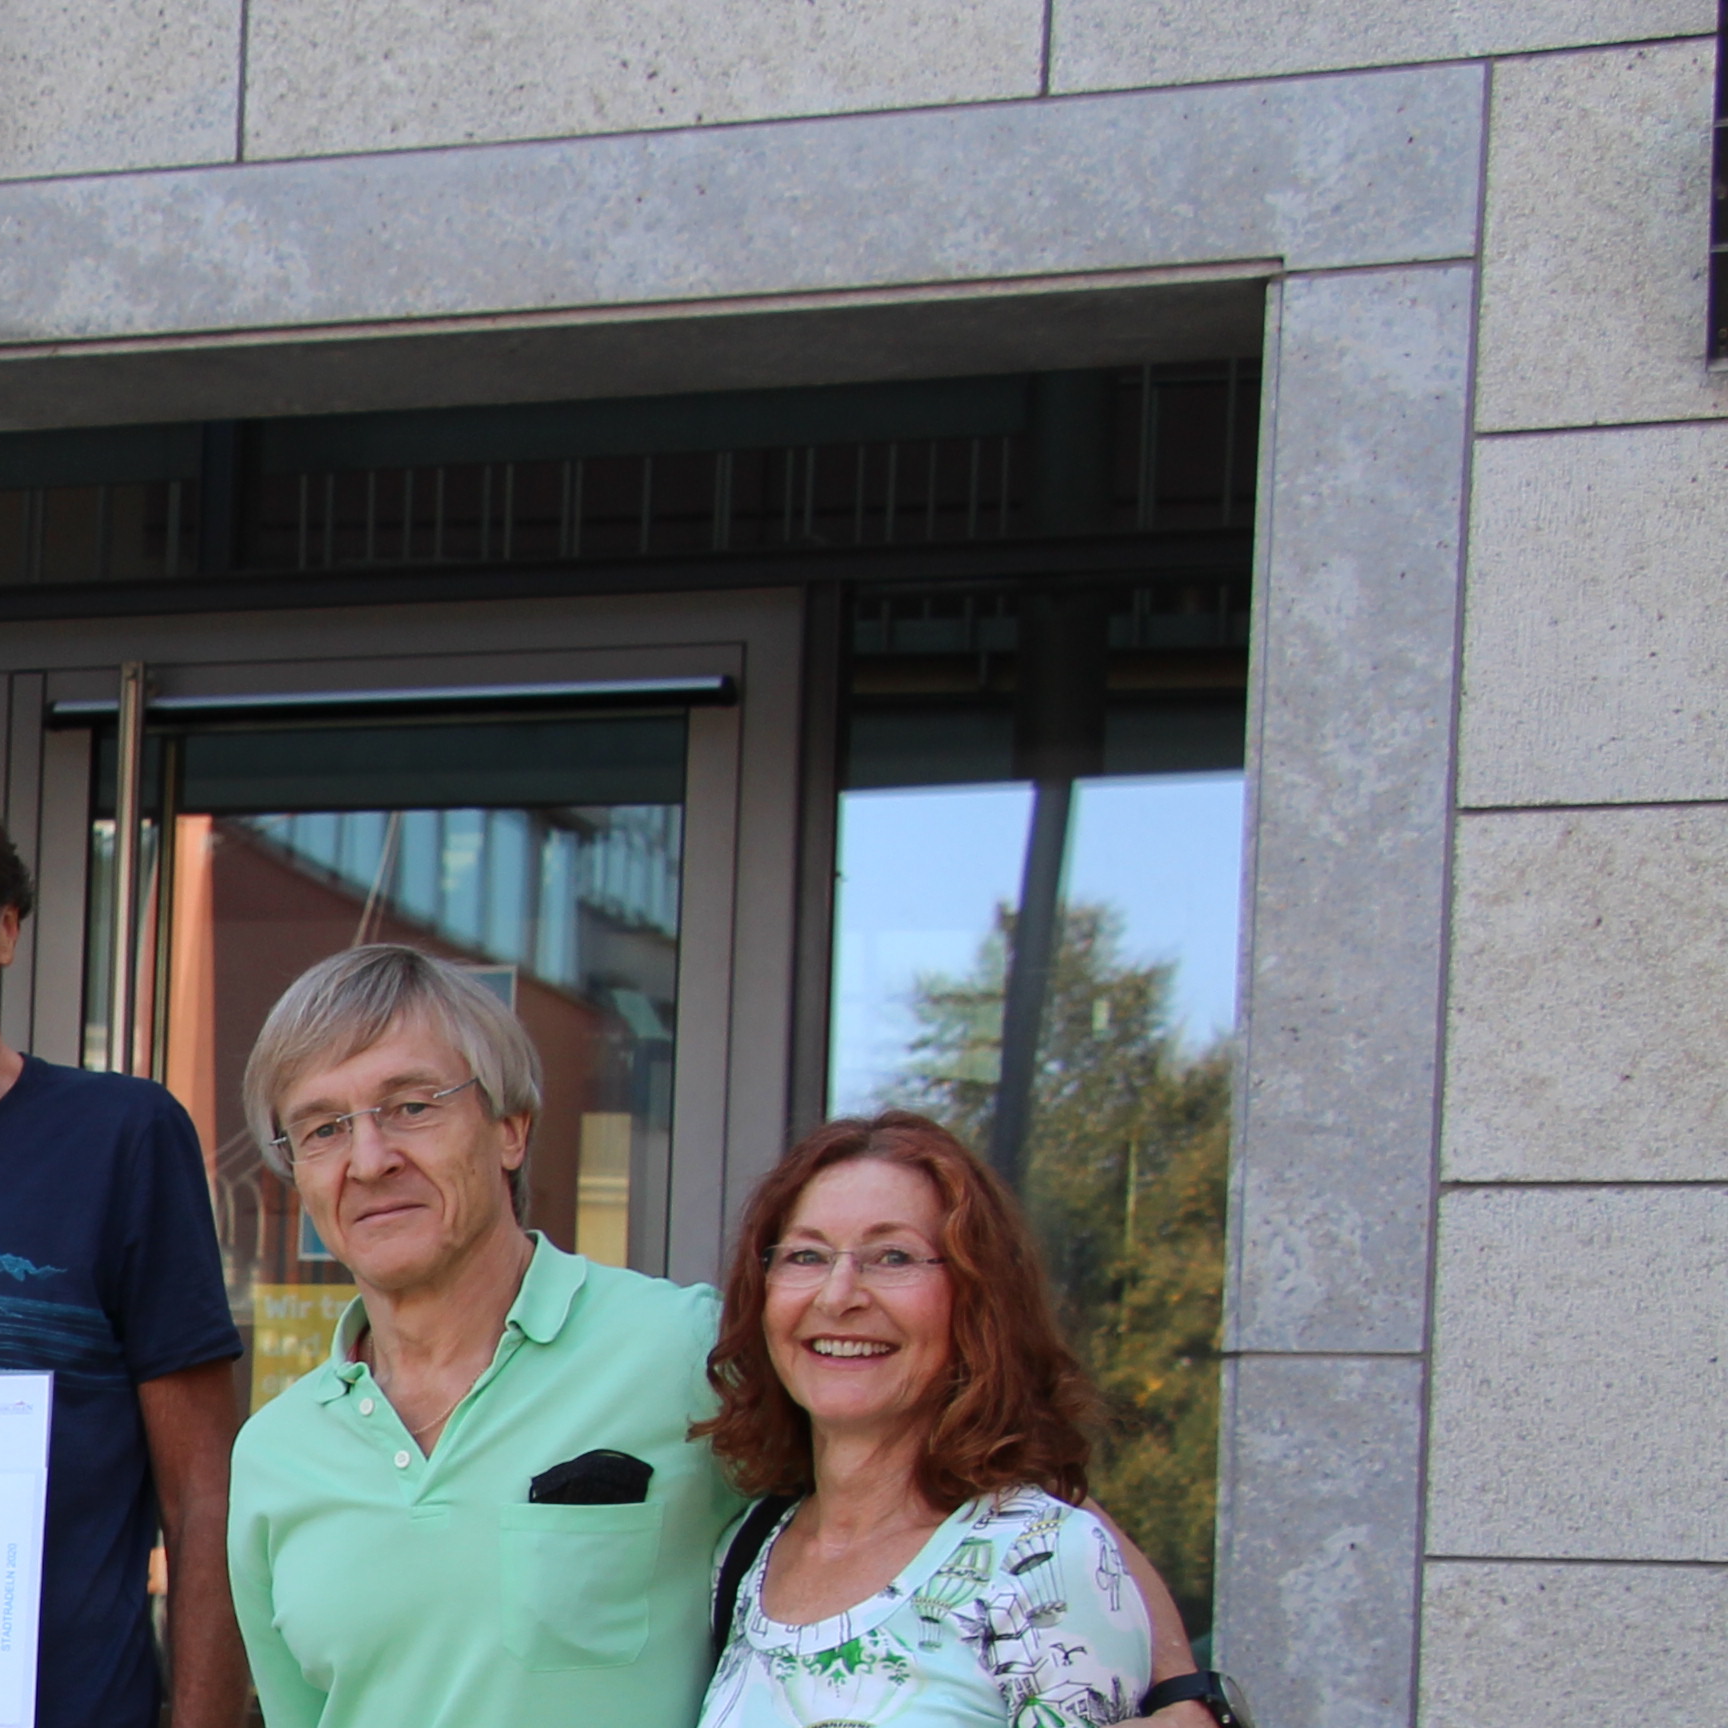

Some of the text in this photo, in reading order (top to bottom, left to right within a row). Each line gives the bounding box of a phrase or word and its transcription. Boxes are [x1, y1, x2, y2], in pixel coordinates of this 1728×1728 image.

[263, 1294, 313, 1319] Wir
[0, 1542, 17, 1652] STADTRADELN 2020
